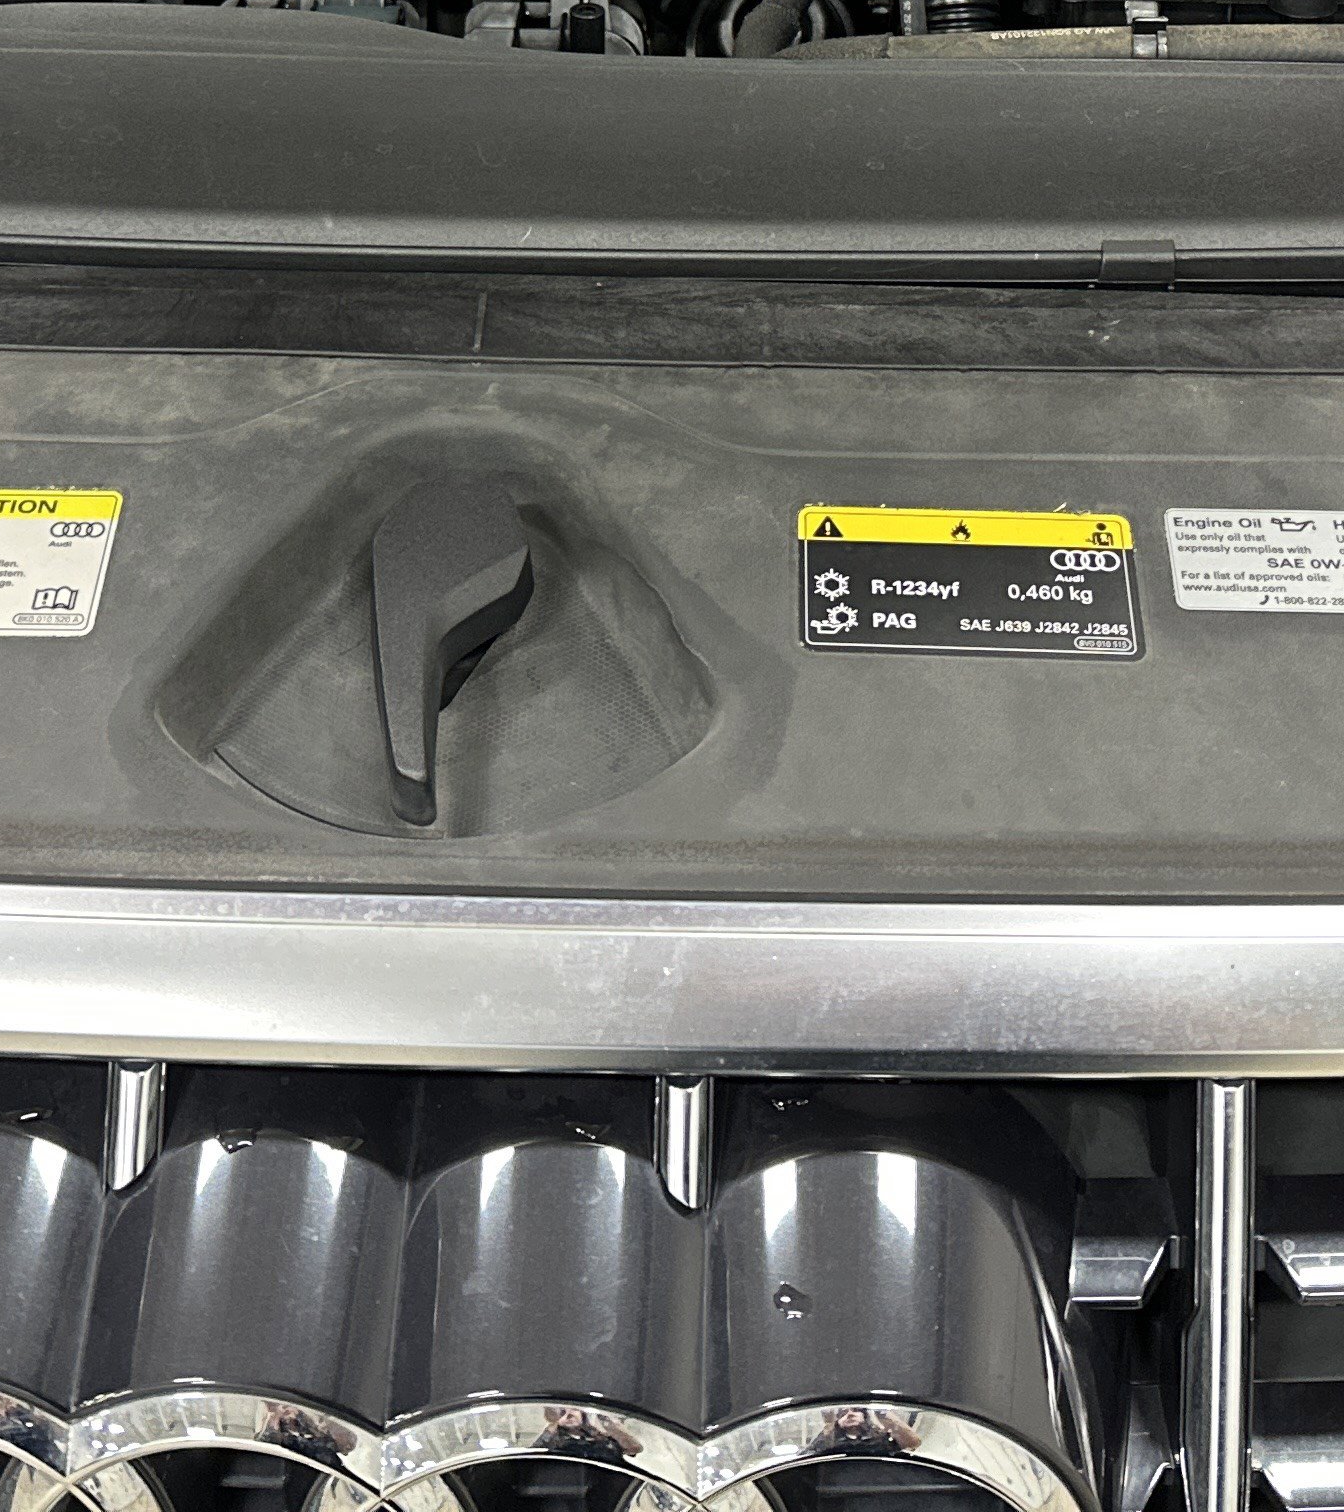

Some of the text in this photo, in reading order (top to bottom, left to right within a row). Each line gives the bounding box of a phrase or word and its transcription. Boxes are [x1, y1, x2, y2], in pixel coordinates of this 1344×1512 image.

[1172, 516, 1262, 529] Engine Oil
[1174, 531, 1267, 543] Use only oil that
[47, 540, 73, 548] Audi
[1177, 544, 1312, 555] expressly complies with
[1266, 557, 1305, 569] SAE
[1054, 573, 1085, 583] Audi
[1180, 569, 1201, 580] For
[1202, 572, 1211, 580] a
[1212, 570, 1231, 580] list
[1233, 570, 1246, 581] of
[1248, 572, 1304, 582] approved
[871, 578, 959, 599] R-1234yf
[1007, 583, 1093, 605] 0,460 kg
[1182, 583, 1287, 593] www.audiusa.com
[872, 612, 917, 629] PAG
[959, 618, 1129, 636] SAE J639 J2842 J2845
